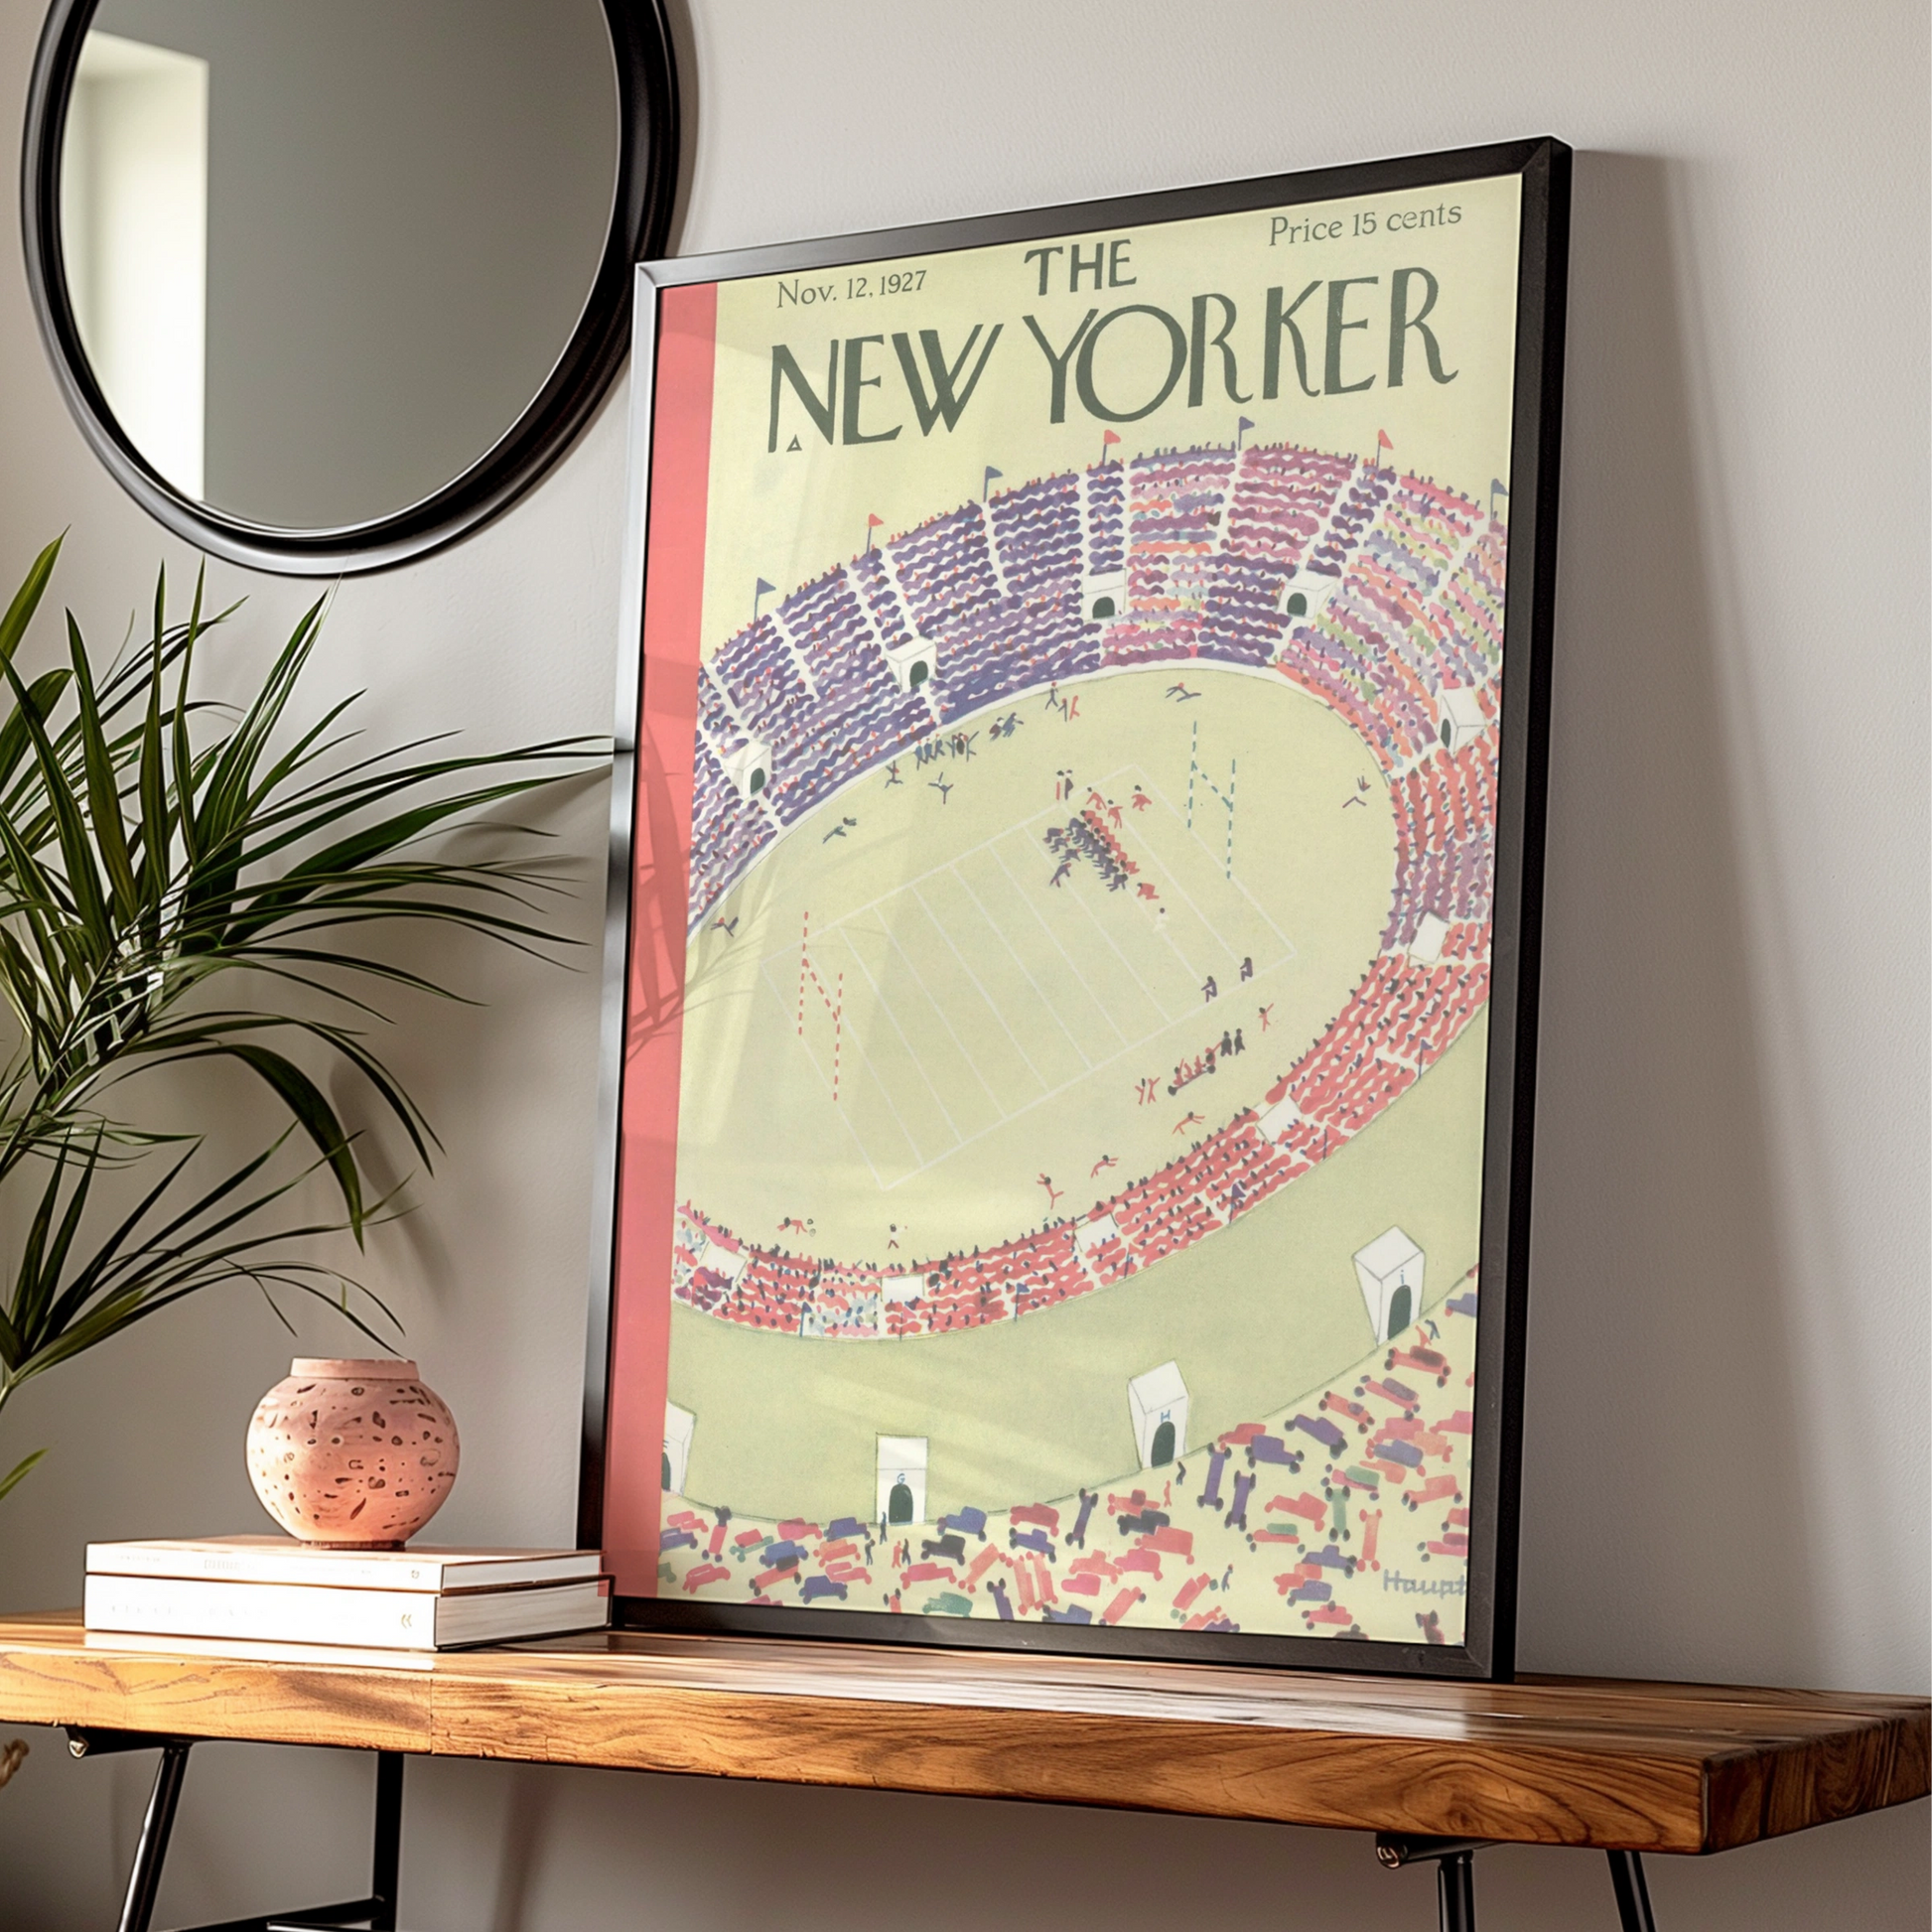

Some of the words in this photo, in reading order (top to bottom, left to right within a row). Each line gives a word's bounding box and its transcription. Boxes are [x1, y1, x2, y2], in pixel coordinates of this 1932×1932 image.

[1269, 215, 1343, 247] Price
[1352, 211, 1378, 237] 15
[1386, 203, 1462, 231] cents
[1024, 238, 1138, 296] THE
[776, 278, 838, 309] Nov.
[767, 323, 1004, 454] NEW
[1023, 266, 1459, 425] YORKER
[1161, 1409, 1171, 1424] H
[1383, 1569, 1466, 1599] Haupt
